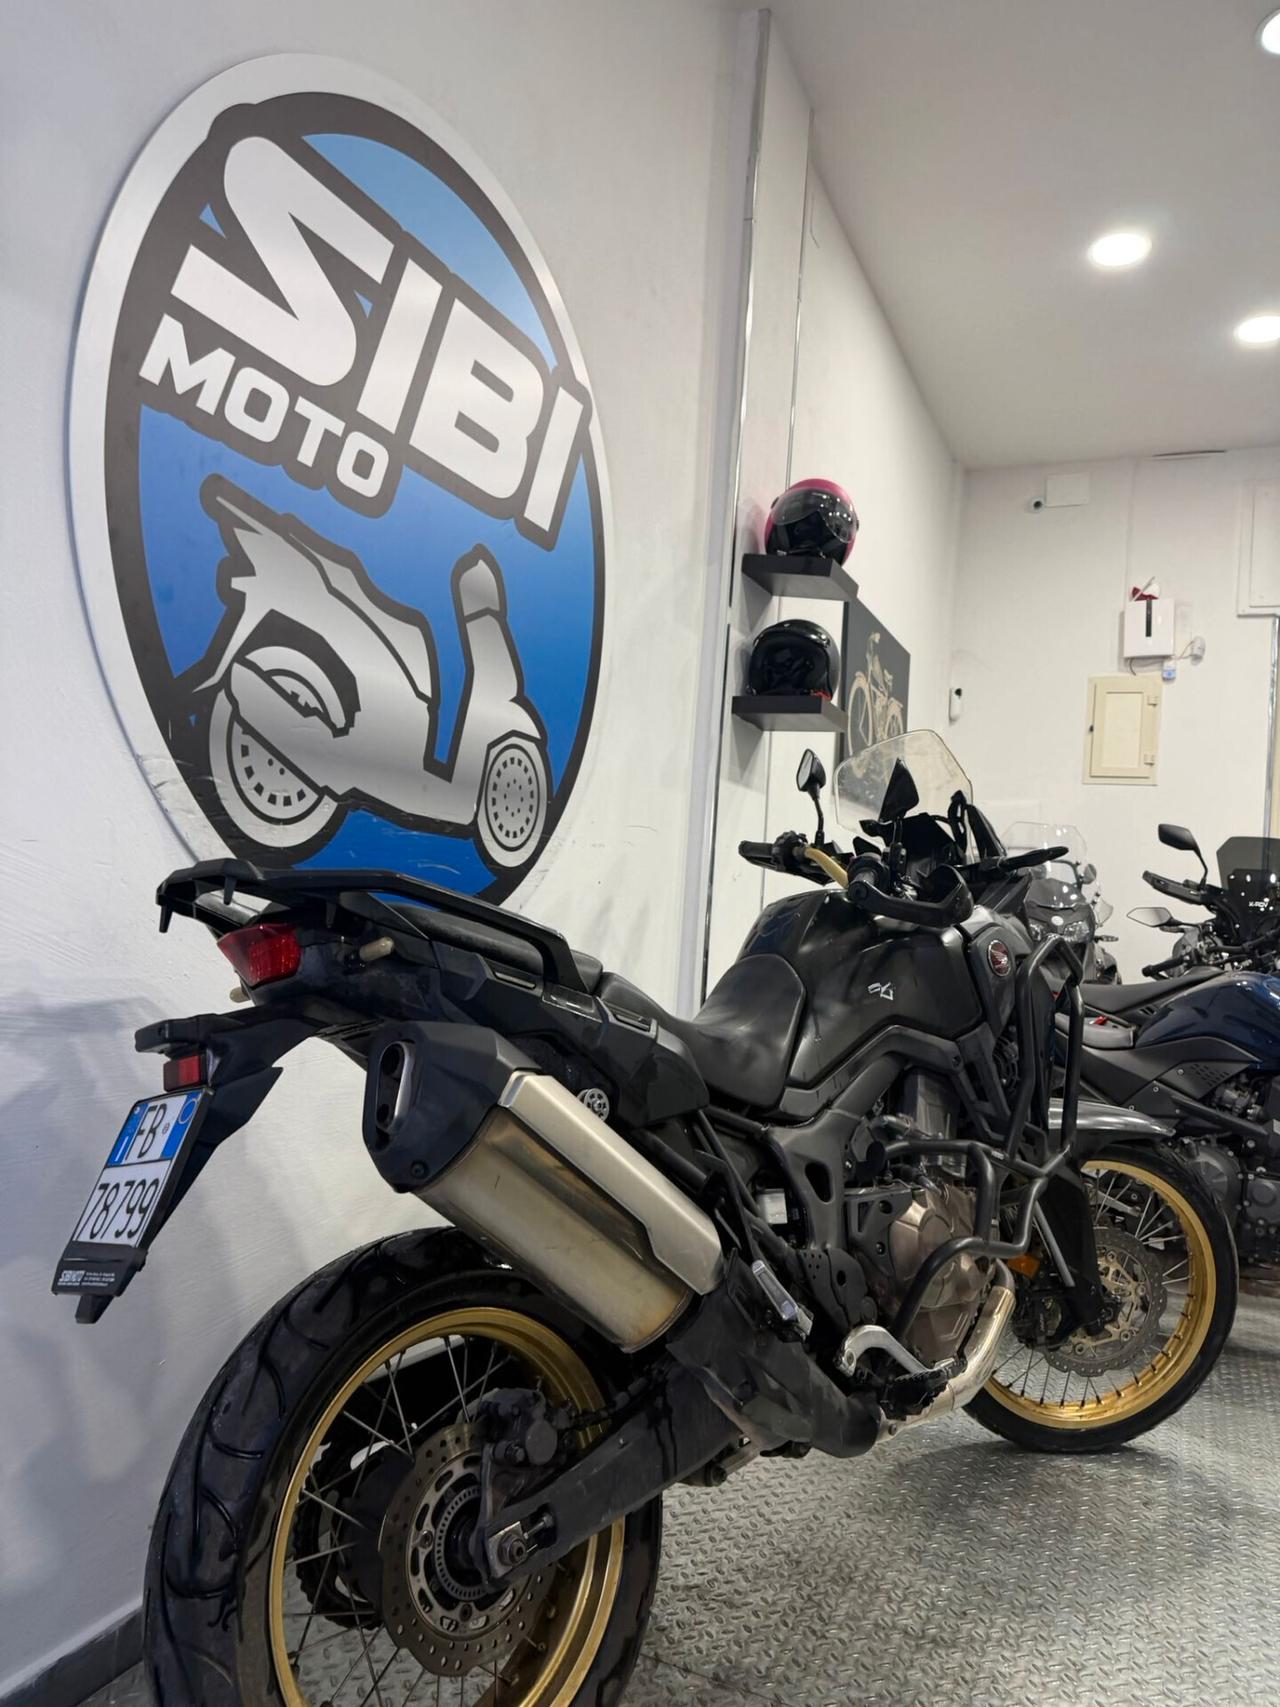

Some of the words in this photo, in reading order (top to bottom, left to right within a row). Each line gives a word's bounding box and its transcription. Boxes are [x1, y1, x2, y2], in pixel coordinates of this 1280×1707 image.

[170, 136, 584, 531] SIBI
[139, 313, 391, 498] MOTO
[125, 1103, 167, 1161] FB
[77, 1178, 160, 1242] 78799
